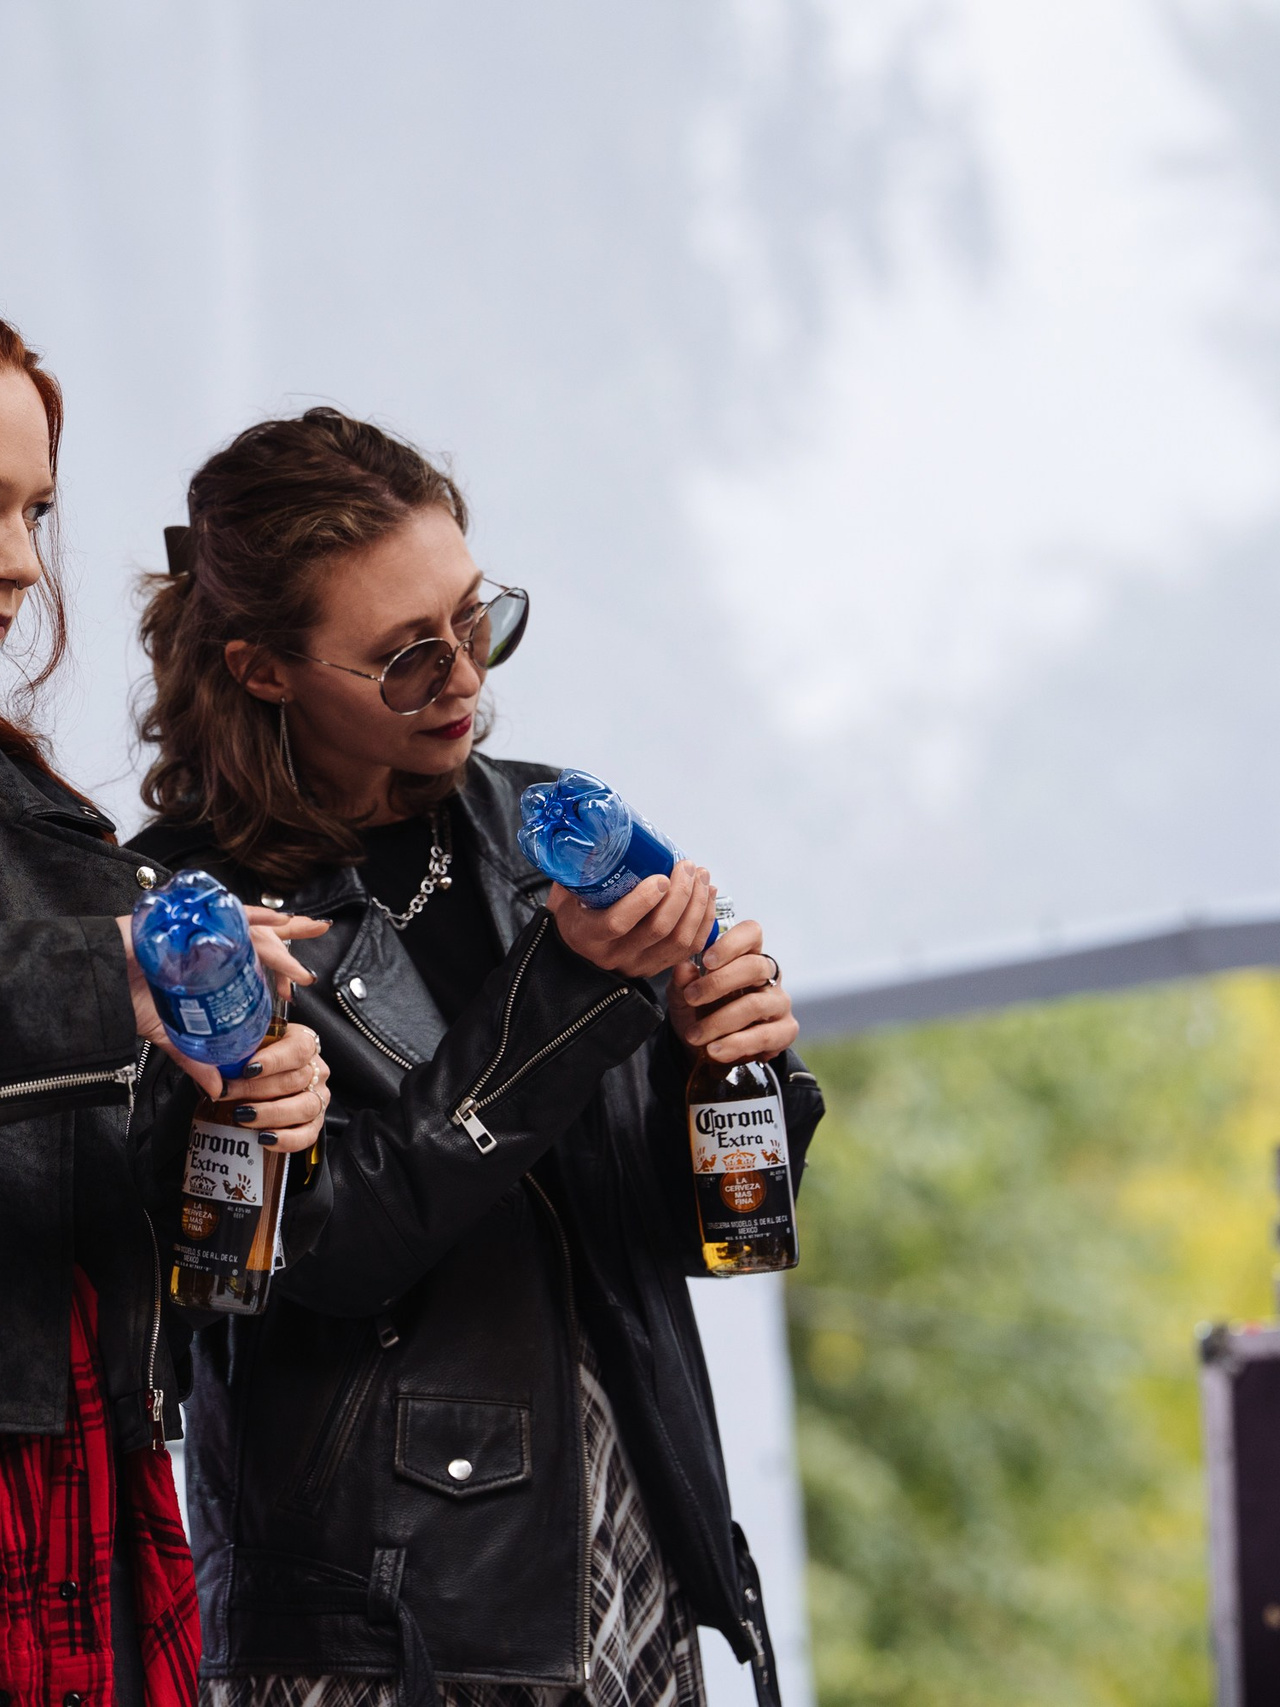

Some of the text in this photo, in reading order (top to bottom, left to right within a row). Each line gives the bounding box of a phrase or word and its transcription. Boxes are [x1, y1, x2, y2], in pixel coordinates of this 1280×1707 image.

[216, 995, 254, 1026] TASSAY
[695, 1107, 775, 1137] Corona
[716, 1132, 764, 1149] Extra
[190, 1150, 230, 1176] Extra
[736, 1177, 748, 1185] LA
[724, 1183, 761, 1193] CERVEZA
[734, 1190, 753, 1199] MAS
[193, 1202, 202, 1210] LA
[735, 1197, 754, 1206] FINA
[189, 1216, 204, 1226] MAS
[188, 1223, 203, 1233] FINA
